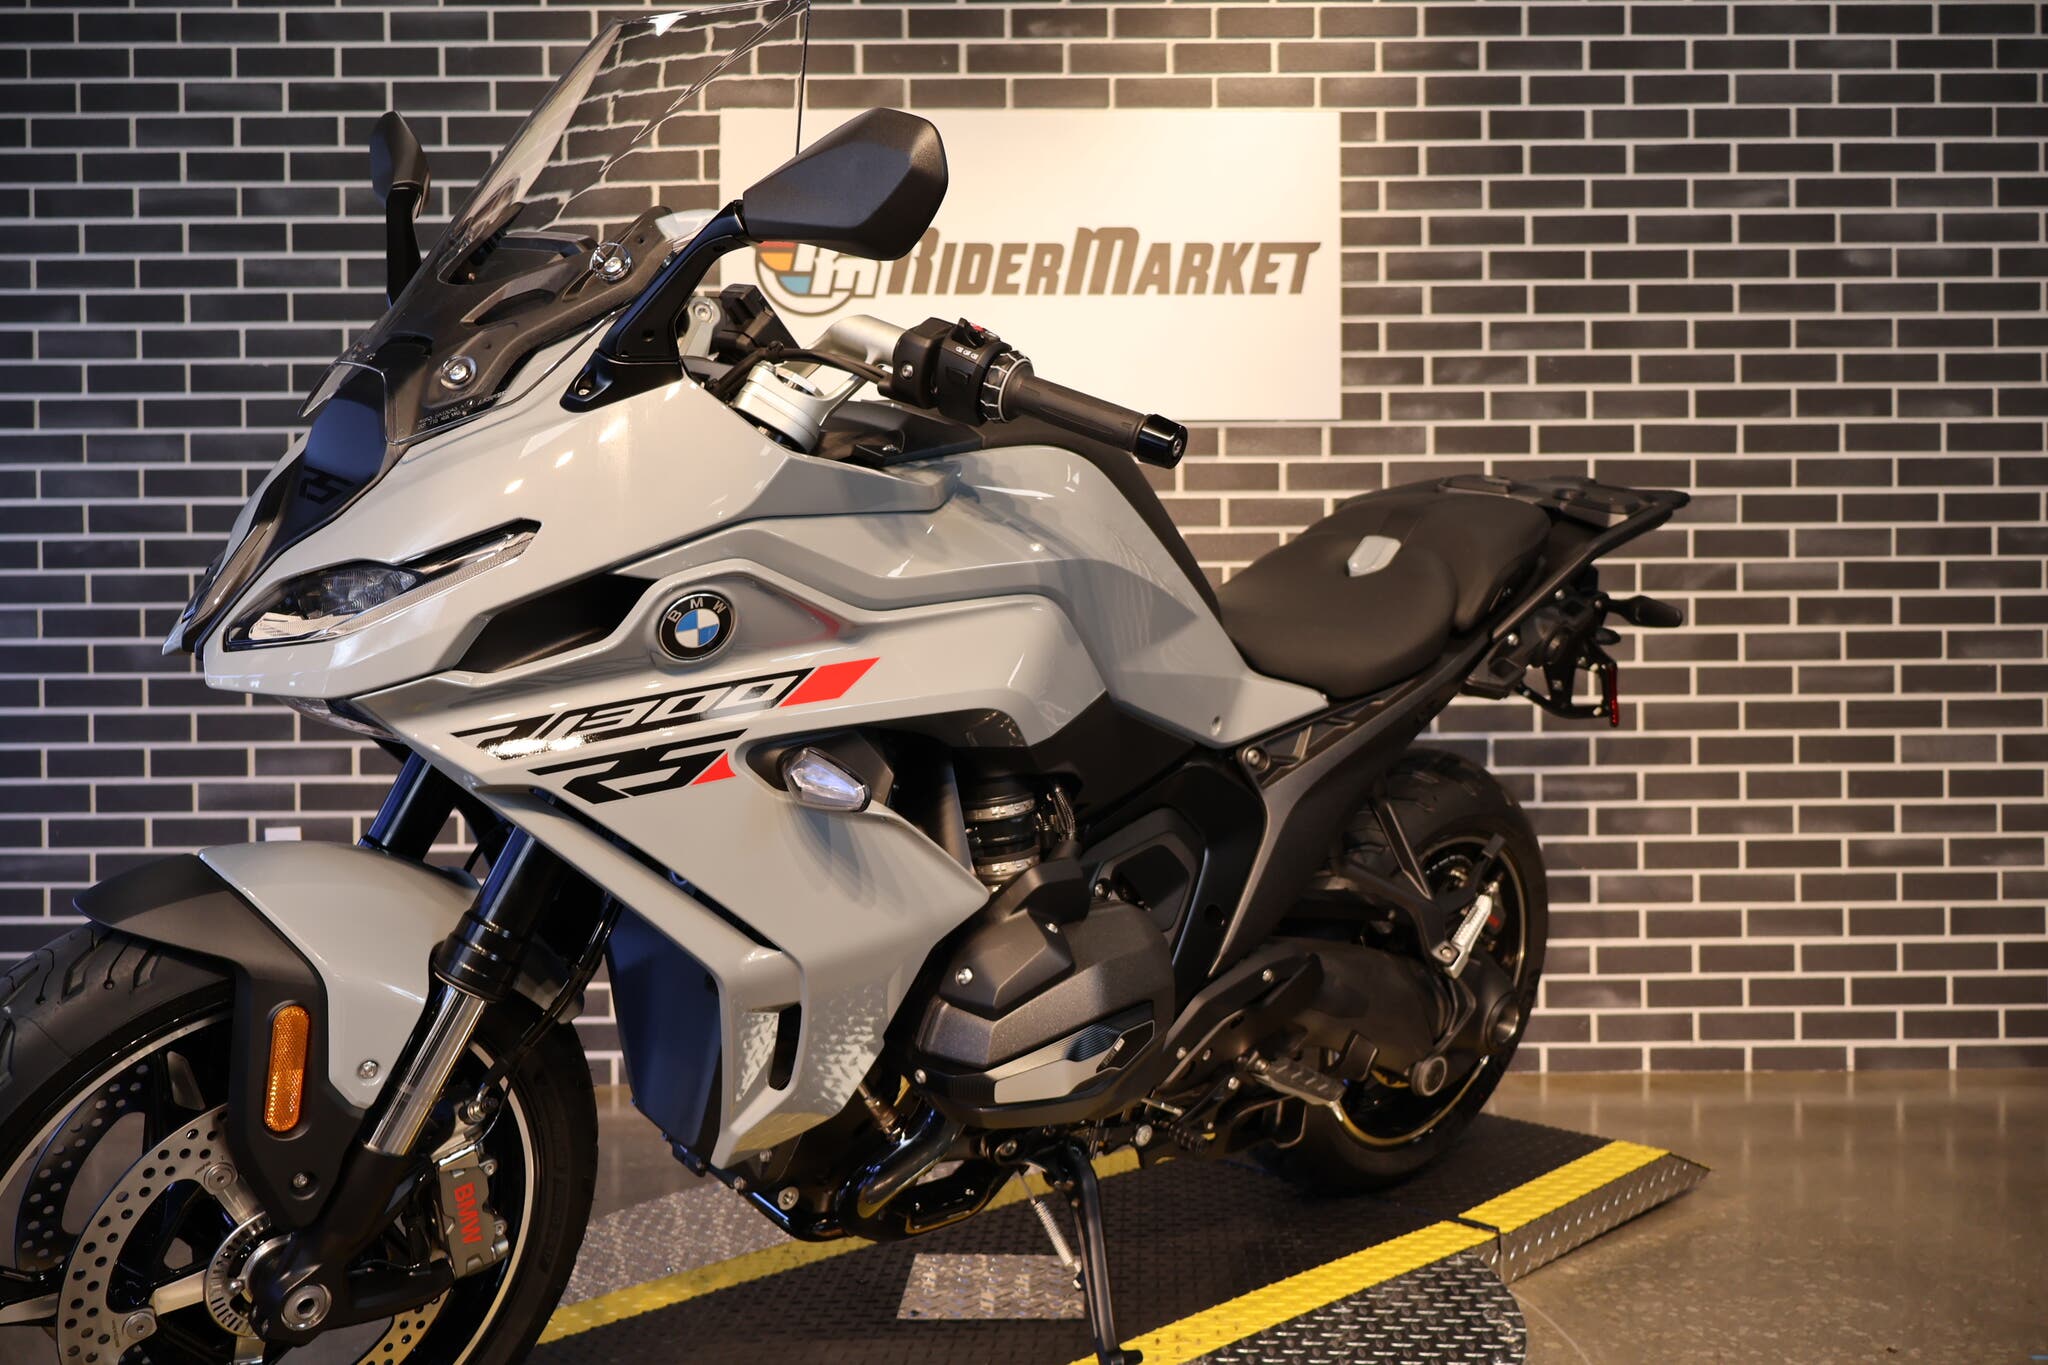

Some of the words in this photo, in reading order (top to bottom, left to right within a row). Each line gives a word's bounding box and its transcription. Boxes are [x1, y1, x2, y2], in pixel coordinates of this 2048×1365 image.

[667, 597, 727, 623] BMW
[527, 728, 748, 804] RS
[454, 1182, 484, 1244] BMW
